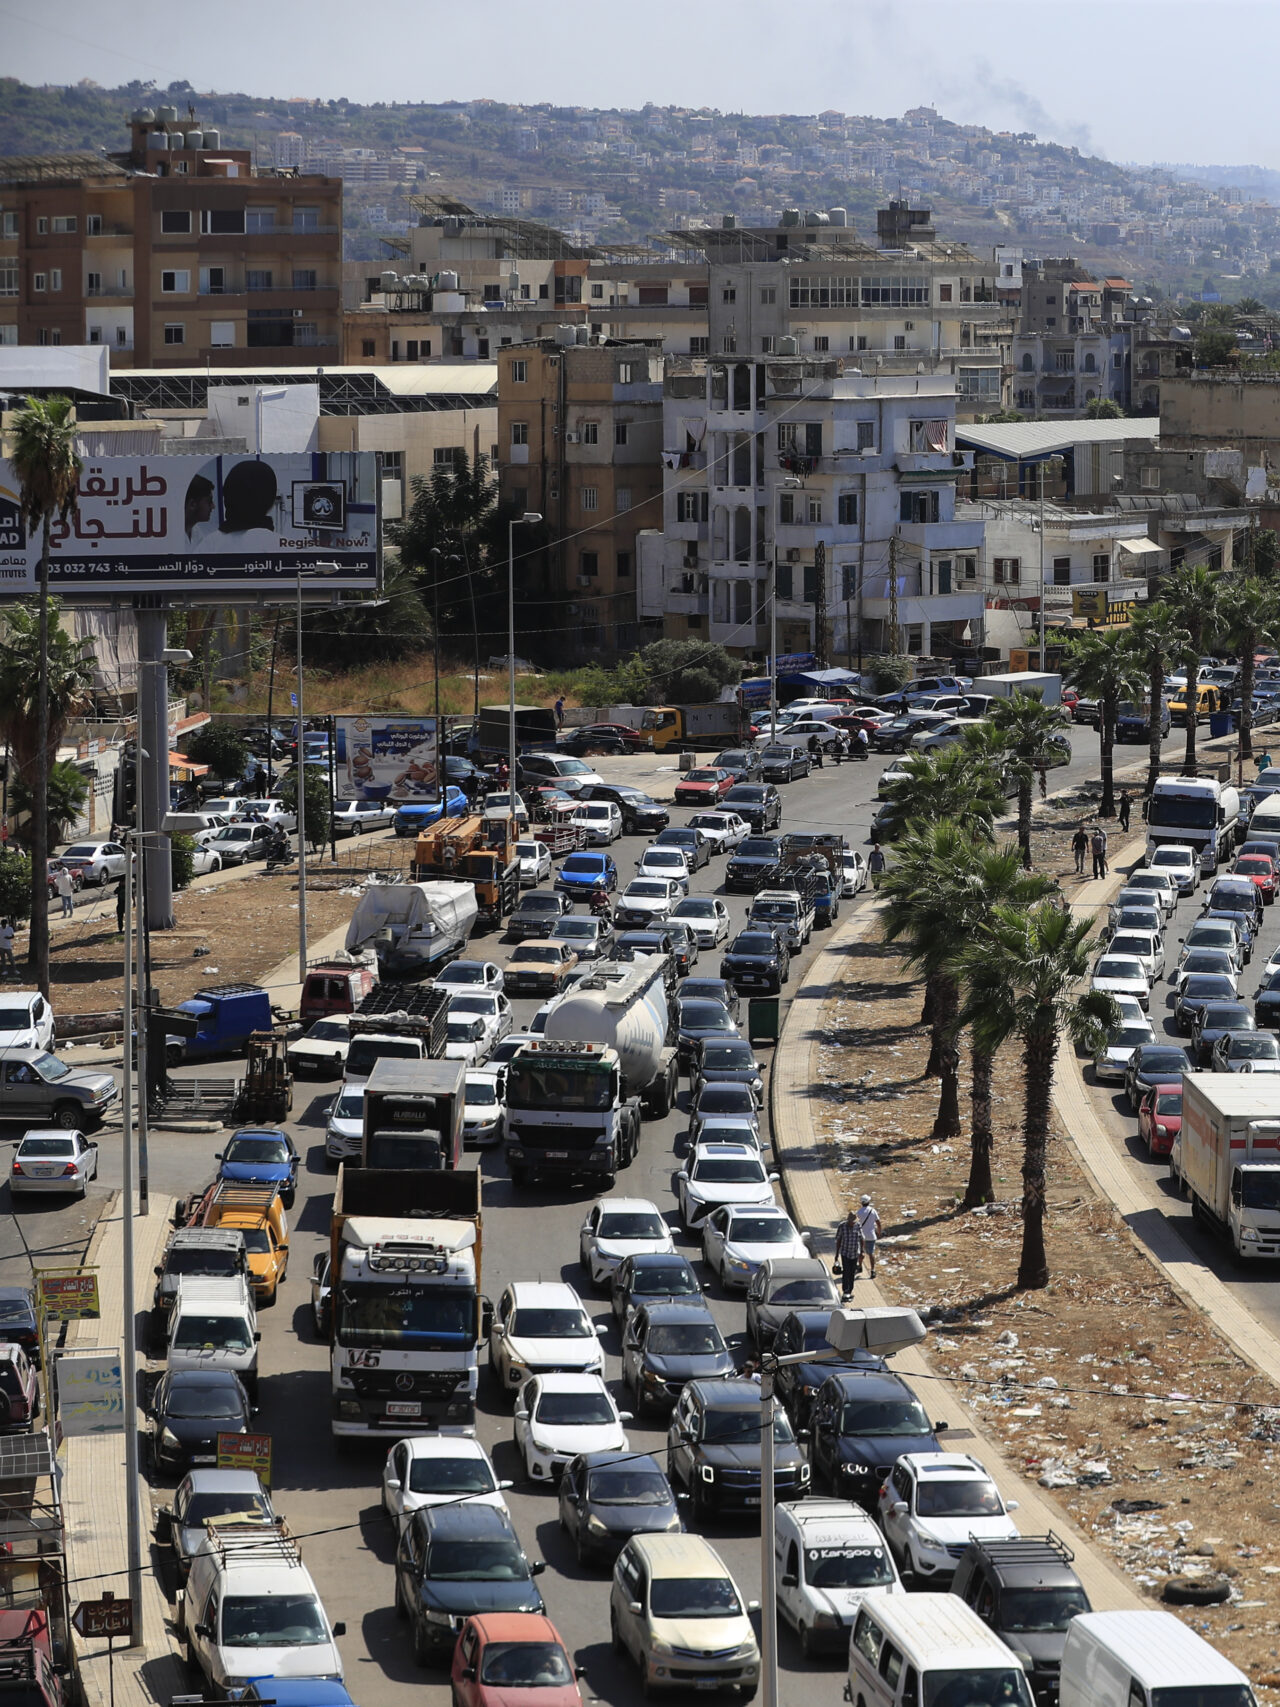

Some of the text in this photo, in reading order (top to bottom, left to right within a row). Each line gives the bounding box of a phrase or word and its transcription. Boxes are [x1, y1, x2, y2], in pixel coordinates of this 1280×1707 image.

[336, 536, 369, 548] Now!
[64, 563, 86, 574] 032
[88, 563, 111, 574] 743
[1107, 602, 1127, 613] ANYS
[820, 1549, 872, 1560] Kangoo
